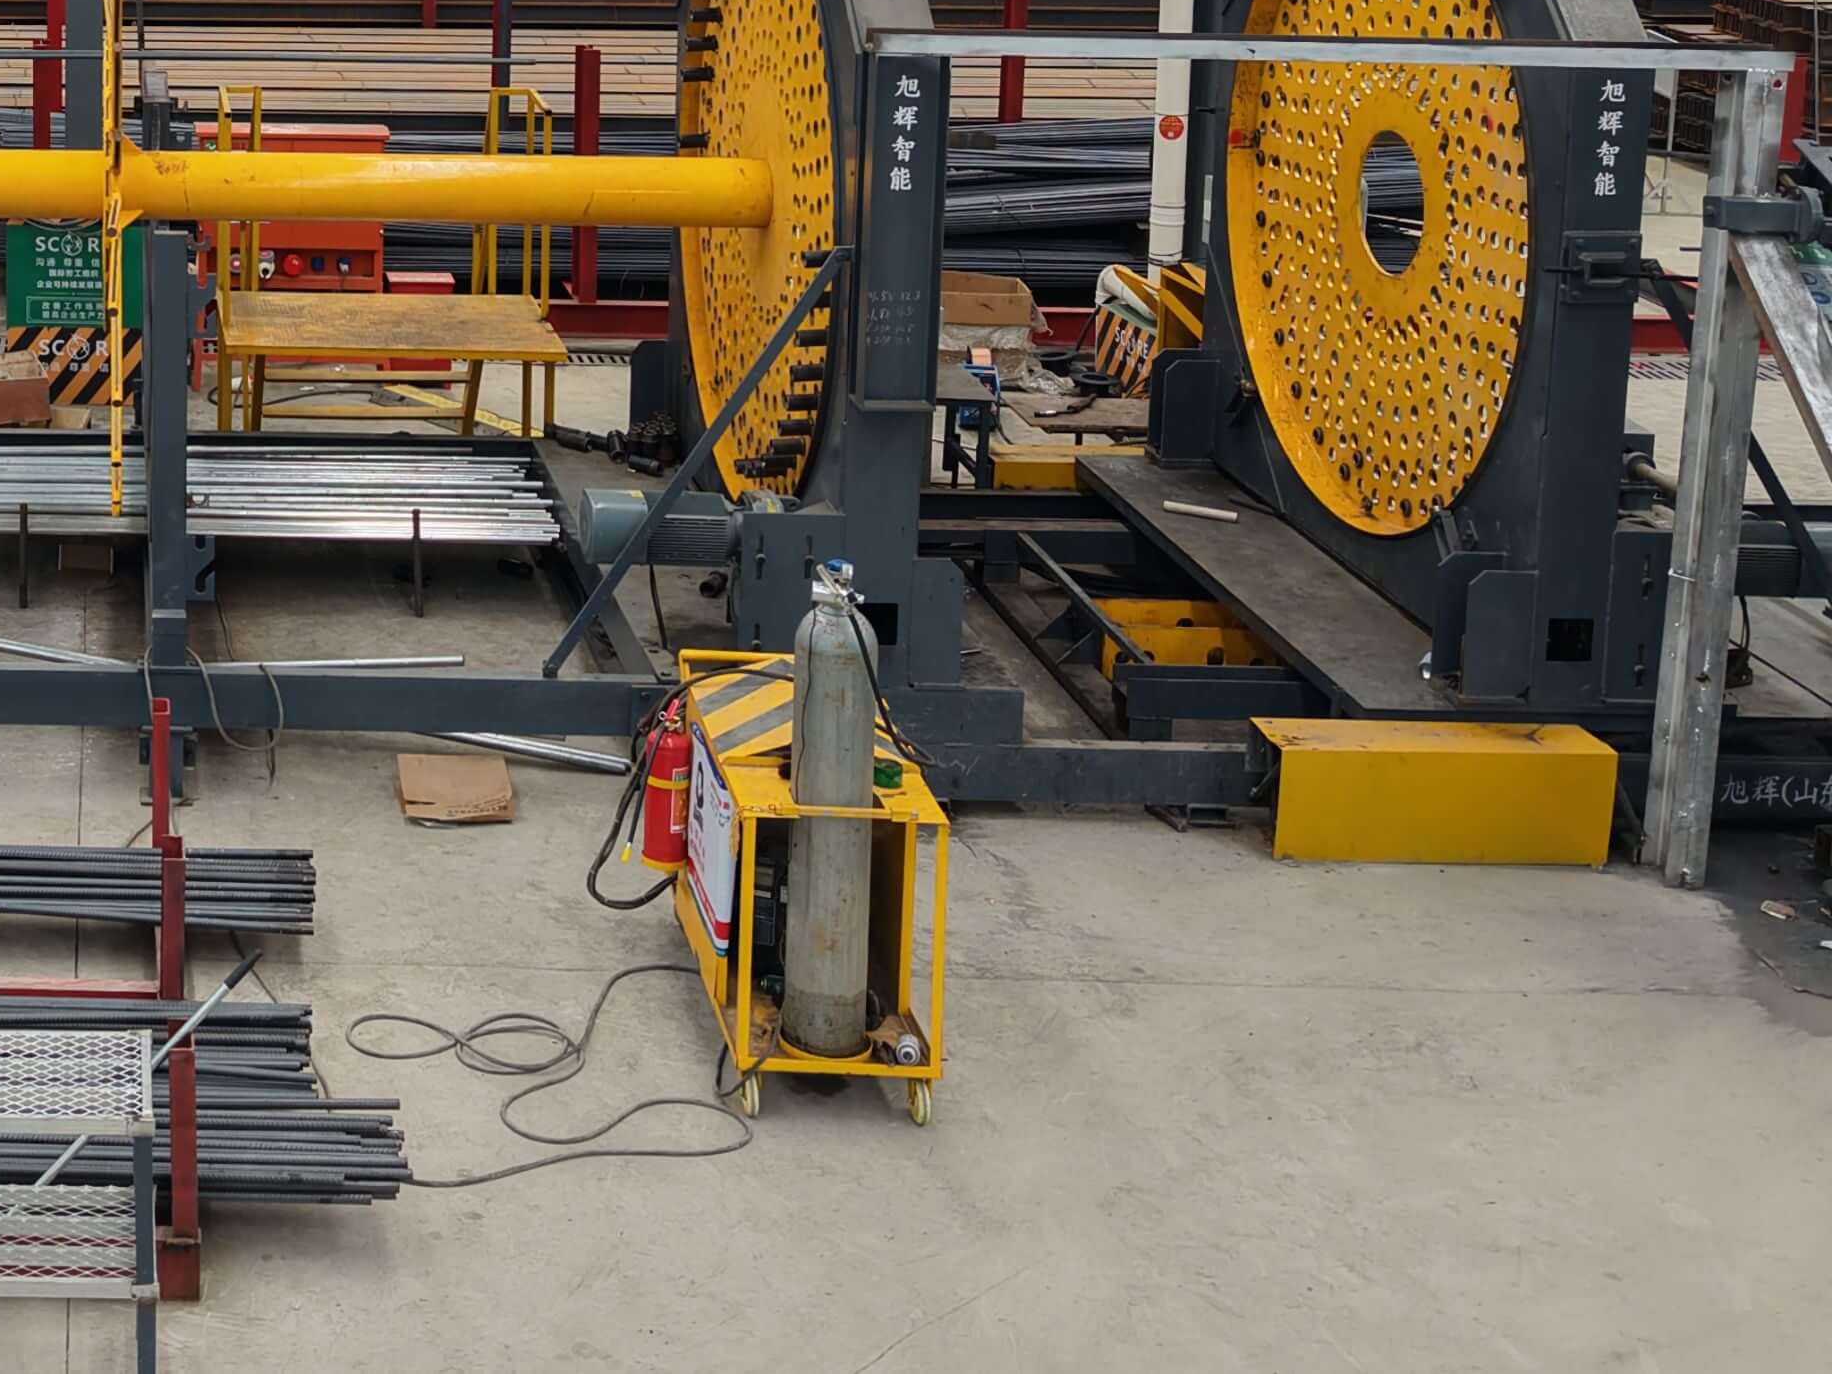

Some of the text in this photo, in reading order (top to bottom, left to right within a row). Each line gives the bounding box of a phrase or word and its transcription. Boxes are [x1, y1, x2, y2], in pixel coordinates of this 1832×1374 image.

[890, 74, 920, 191] 旭辉智能
[1594, 80, 1625, 196] 旭辉智能
